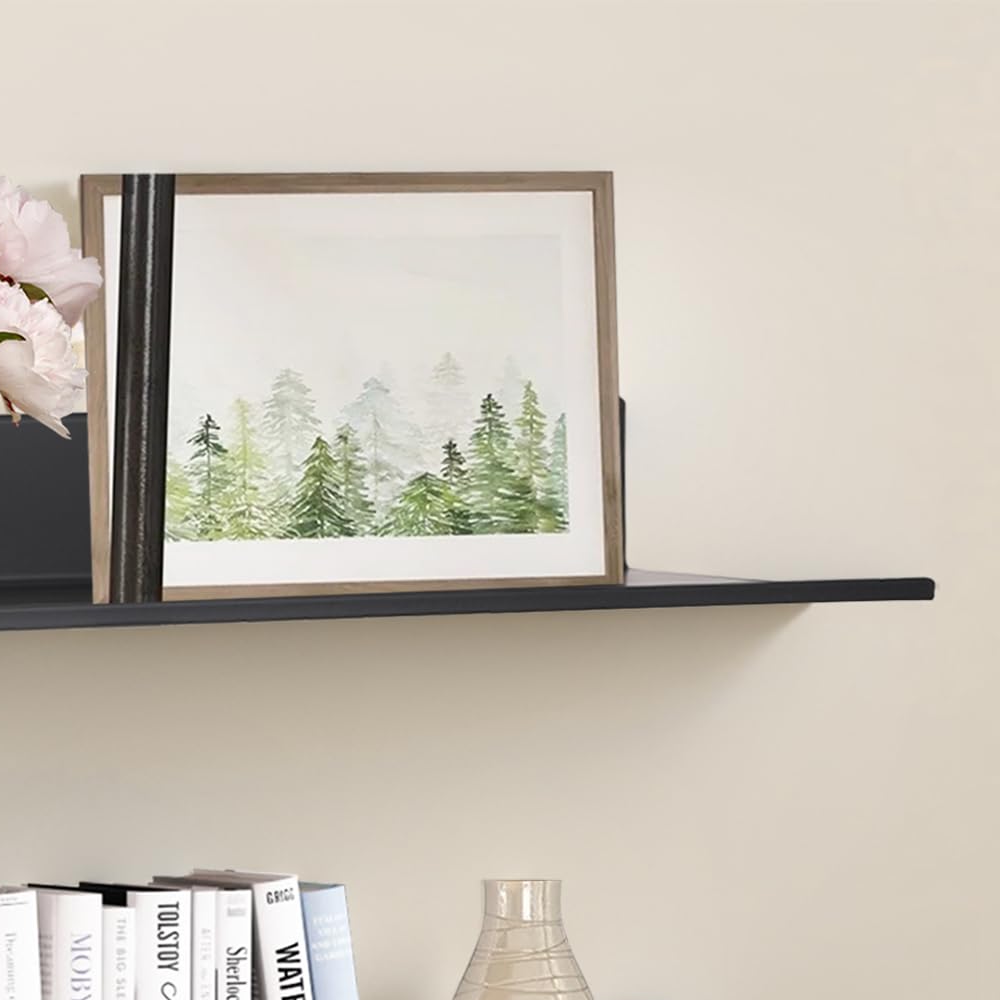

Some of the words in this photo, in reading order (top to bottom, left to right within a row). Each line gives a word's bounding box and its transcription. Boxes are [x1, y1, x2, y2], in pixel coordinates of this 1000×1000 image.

[116, 918, 128, 942] THE
[157, 901, 180, 972] TOLSTOY
[116, 948, 128, 973] BIG
